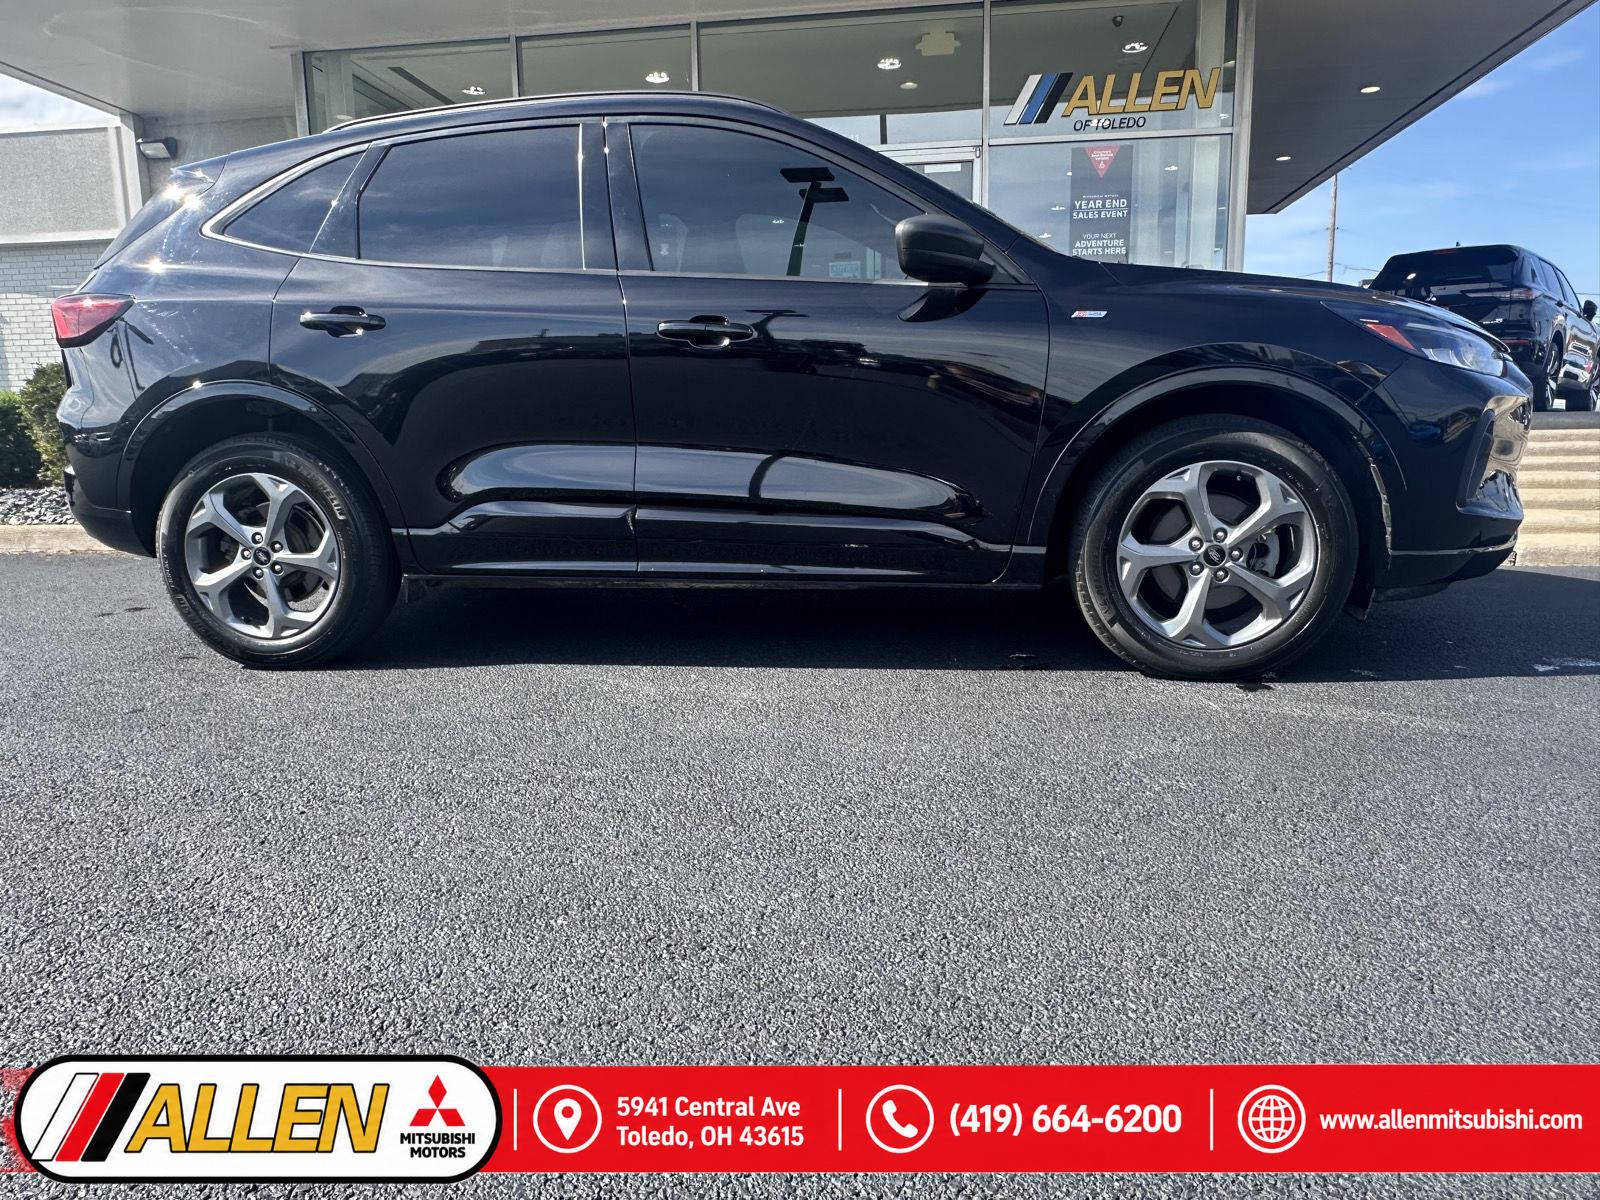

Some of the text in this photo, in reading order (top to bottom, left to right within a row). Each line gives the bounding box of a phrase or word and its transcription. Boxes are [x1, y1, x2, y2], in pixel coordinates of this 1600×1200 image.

[1061, 67, 1221, 117] ALLEN
[1073, 116, 1146, 131] OF TOLEDO
[1074, 199, 1127, 210] YEAR END
[1072, 210, 1128, 219] SALES EVENT
[1074, 239, 1125, 248] ADVENTURE
[1072, 246, 1127, 256] STARTS HERE
